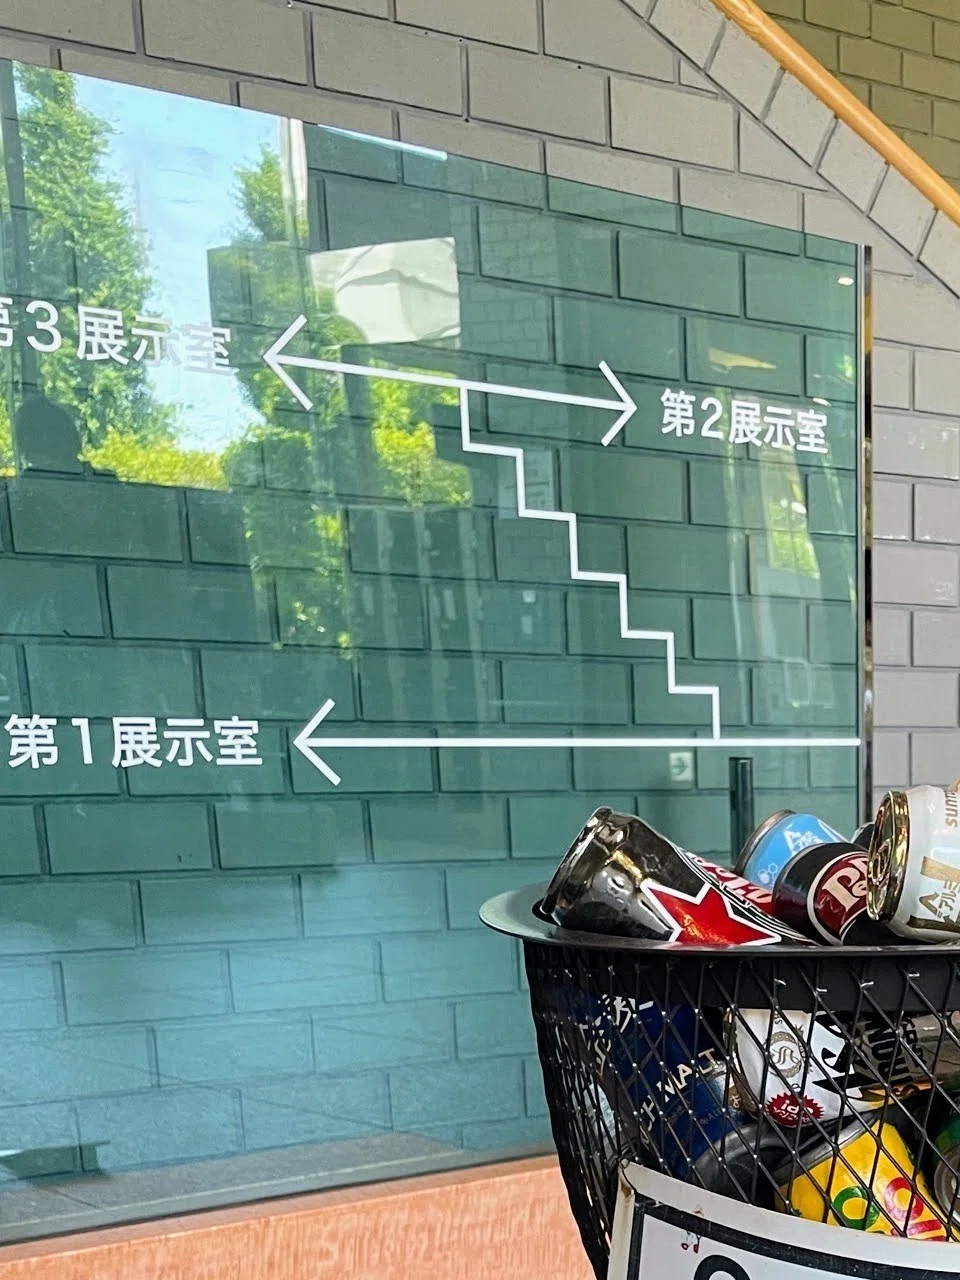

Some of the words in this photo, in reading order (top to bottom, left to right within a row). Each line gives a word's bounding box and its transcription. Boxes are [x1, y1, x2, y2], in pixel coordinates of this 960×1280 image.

[660, 388, 829, 454] 第2展示室
[5, 714, 262, 769] 第1展示室
